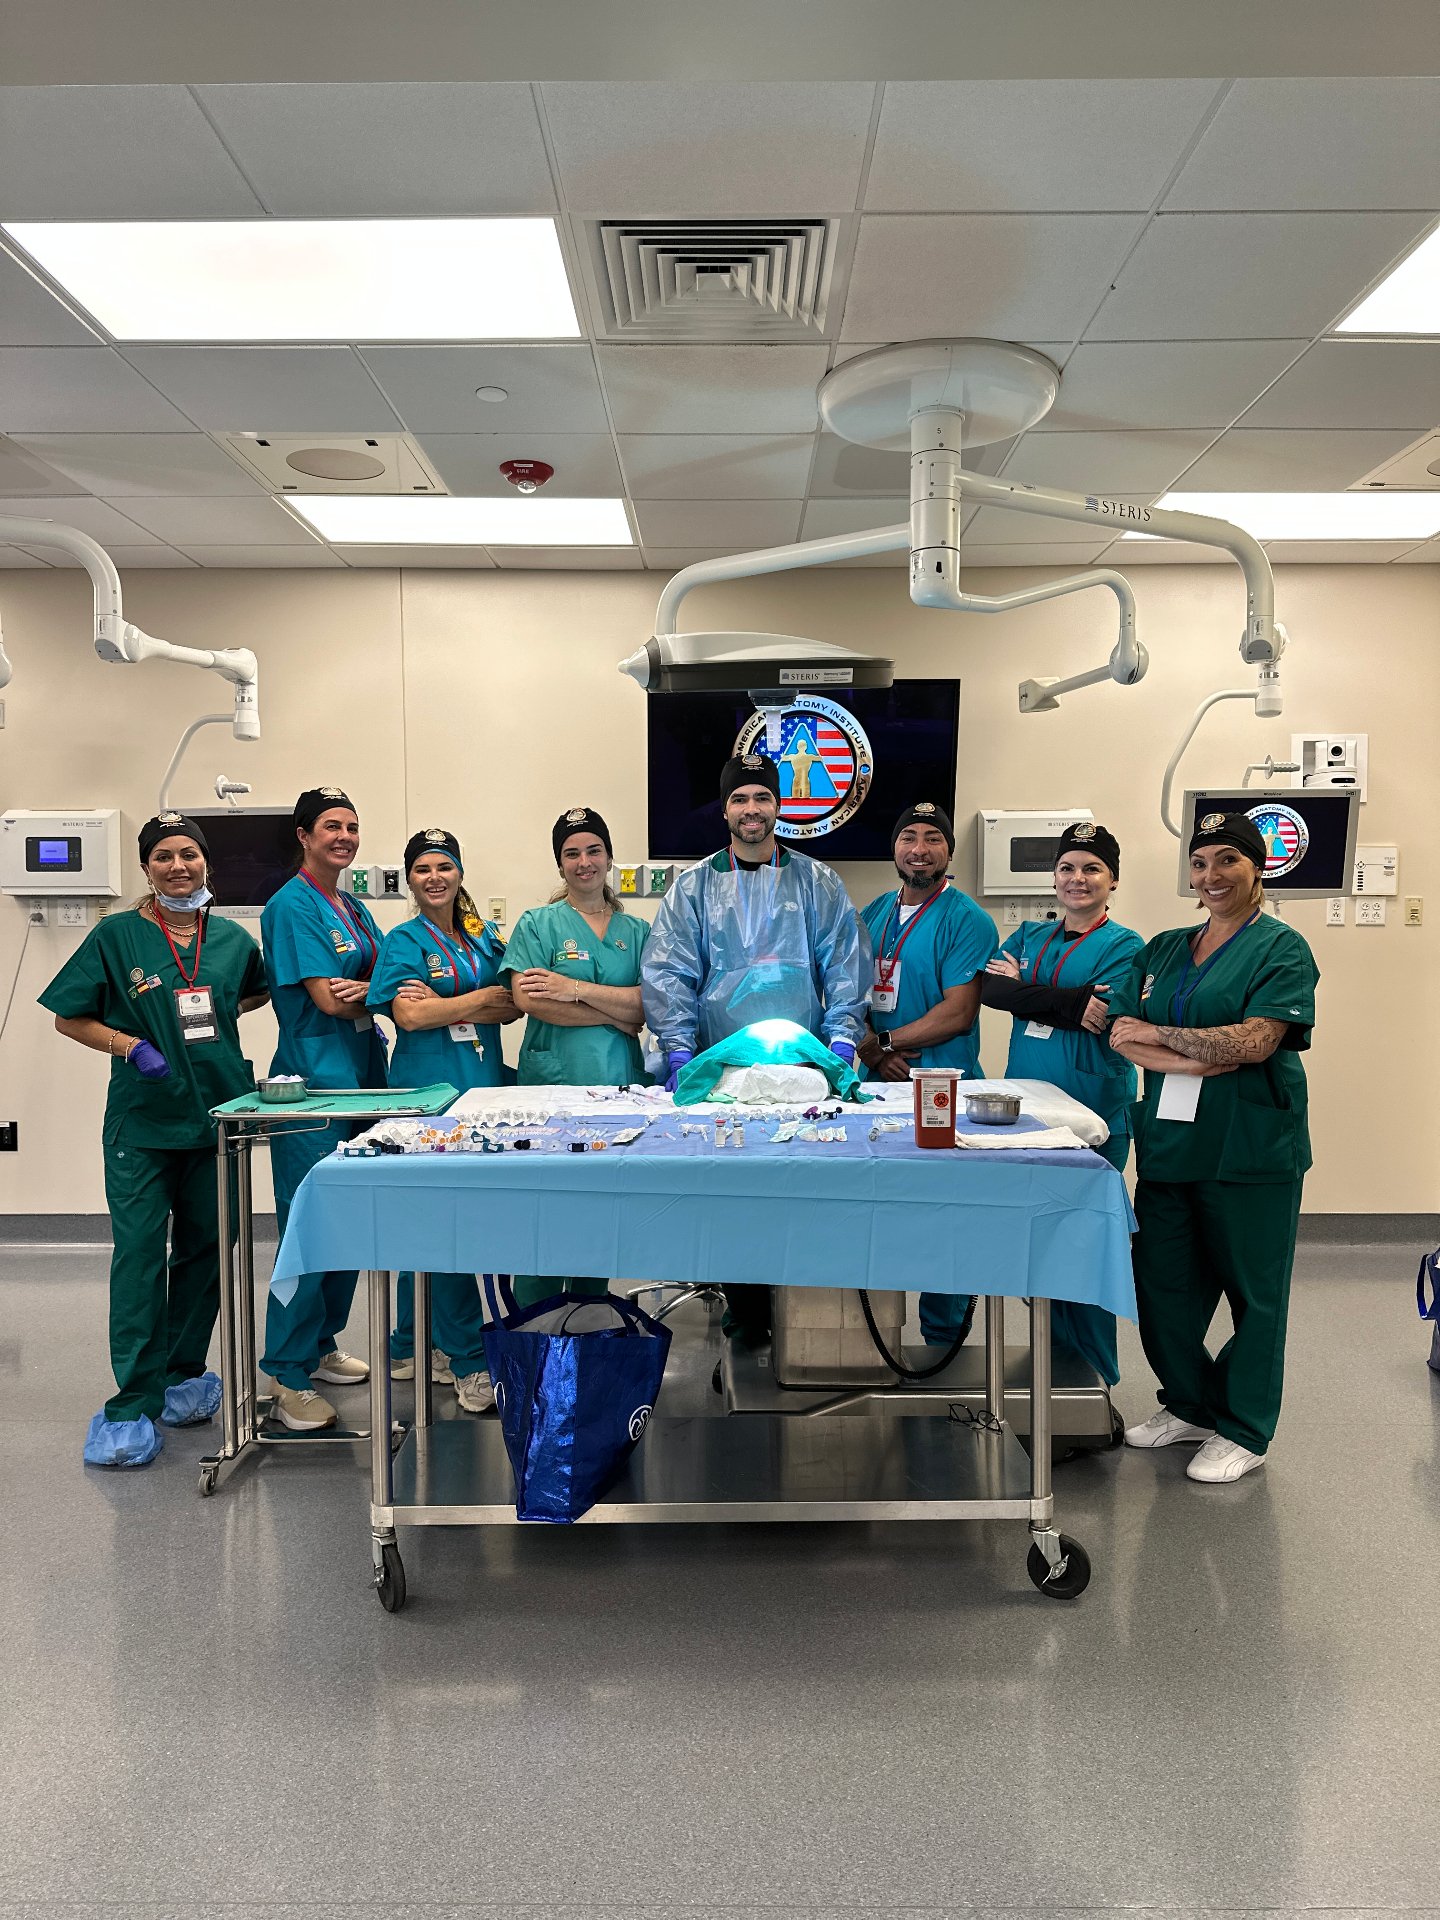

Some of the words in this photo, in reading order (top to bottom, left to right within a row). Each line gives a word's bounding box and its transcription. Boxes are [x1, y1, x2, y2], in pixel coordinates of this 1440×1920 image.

[936, 427, 942, 435] 5
[1102, 500, 1151, 522] STERIS
[790, 673, 819, 681] STERIS
[830, 708, 867, 759] INSTITUTE
[831, 777, 866, 827] AMERICAN
[775, 823, 829, 836] ANATOMY
[1286, 811, 1306, 836] INSTITUTE
